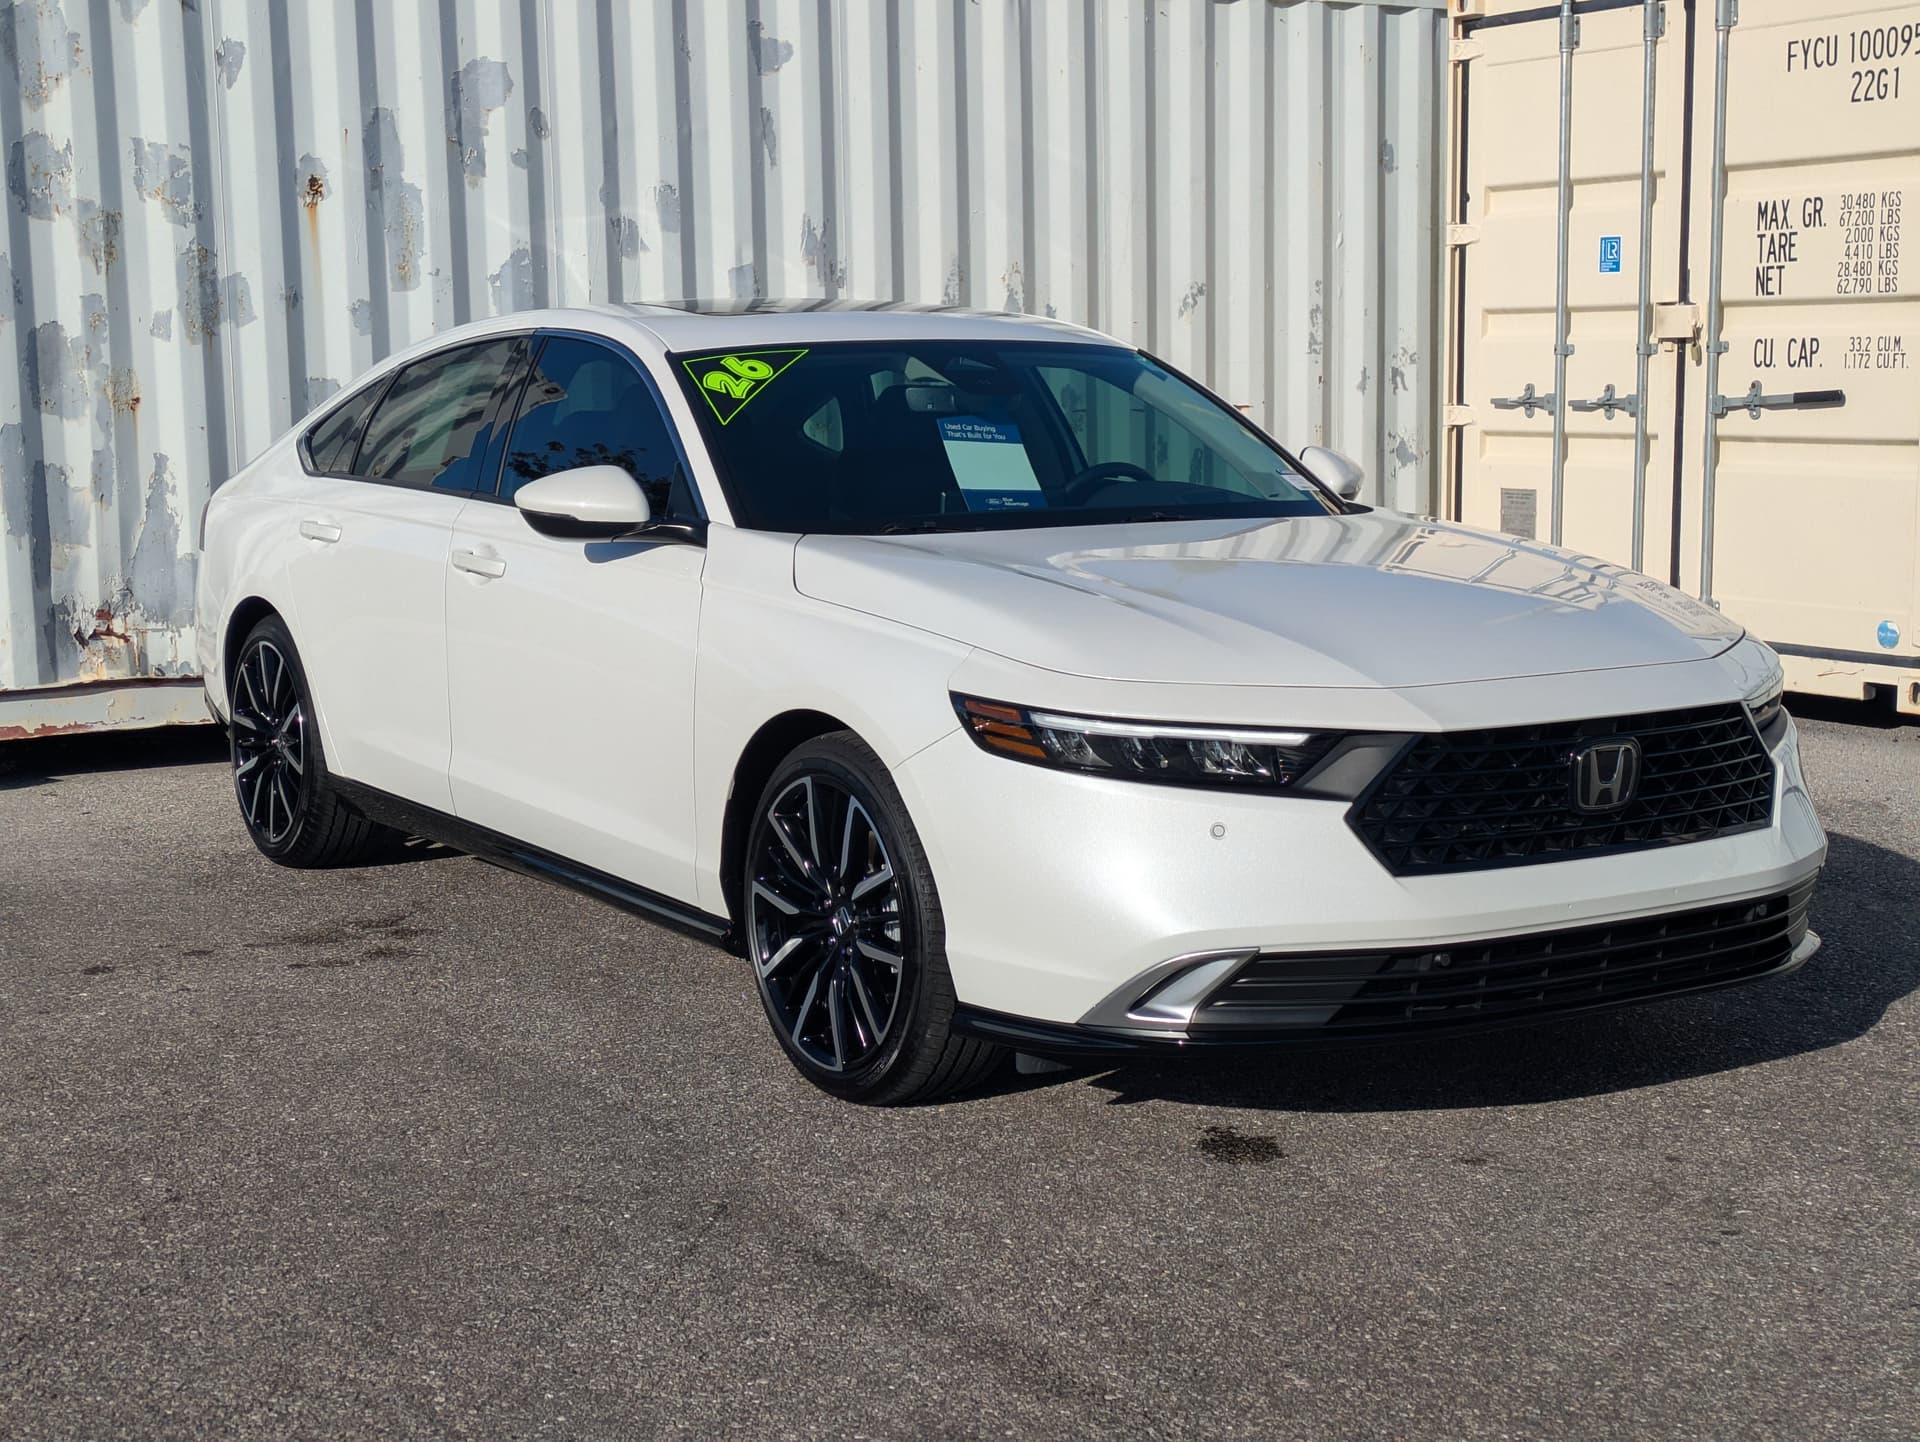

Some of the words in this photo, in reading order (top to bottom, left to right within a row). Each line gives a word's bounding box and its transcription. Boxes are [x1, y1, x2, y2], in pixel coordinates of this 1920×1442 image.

[1787, 34, 1838, 73] FYCU
[1851, 66, 1900, 103] 22G1
[1840, 192, 1876, 210] 30.480
[1881, 191, 1902, 208] KGS
[1757, 199, 1793, 232] MAX.
[1802, 196, 1827, 228] GR.
[1880, 208, 1901, 225] LBS
[1845, 226, 1874, 244] 2.000
[1879, 225, 1900, 242] KGS
[1757, 231, 1798, 264] TARE
[1878, 242, 1900, 259] LBS
[1878, 259, 1899, 276] KGS
[1755, 265, 1786, 297] NET
[1877, 276, 1898, 293] LBS
[1753, 337, 1777, 369] CU.
[1787, 337, 1823, 369] CAP.
[1849, 336, 1872, 352] 33.2
[702, 356, 774, 399] 26
[974, 425, 996, 433] Buying
